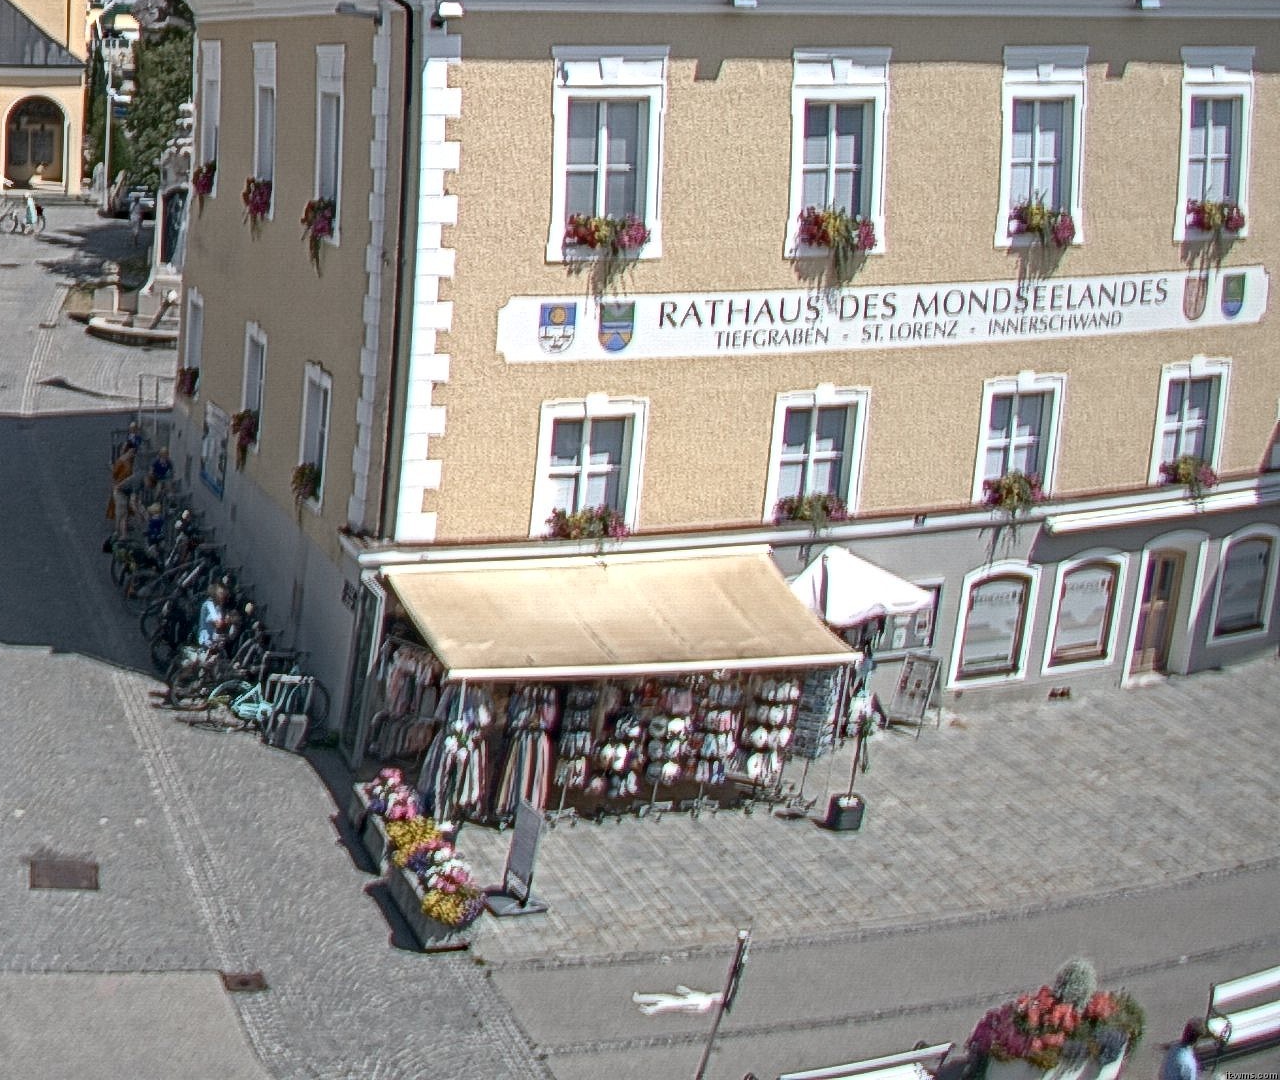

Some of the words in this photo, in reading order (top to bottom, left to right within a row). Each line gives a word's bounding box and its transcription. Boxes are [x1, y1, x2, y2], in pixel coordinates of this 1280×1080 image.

[659, 295, 820, 329] RATHAUS
[839, 291, 897, 321] DES
[912, 277, 1167, 318] MONDSEELANDES
[714, 326, 829, 349] TIEFGRABEN
[861, 323, 884, 343] ST.
[889, 320, 958, 342] LORENZ
[988, 310, 1122, 336] INNERSCHWAND
